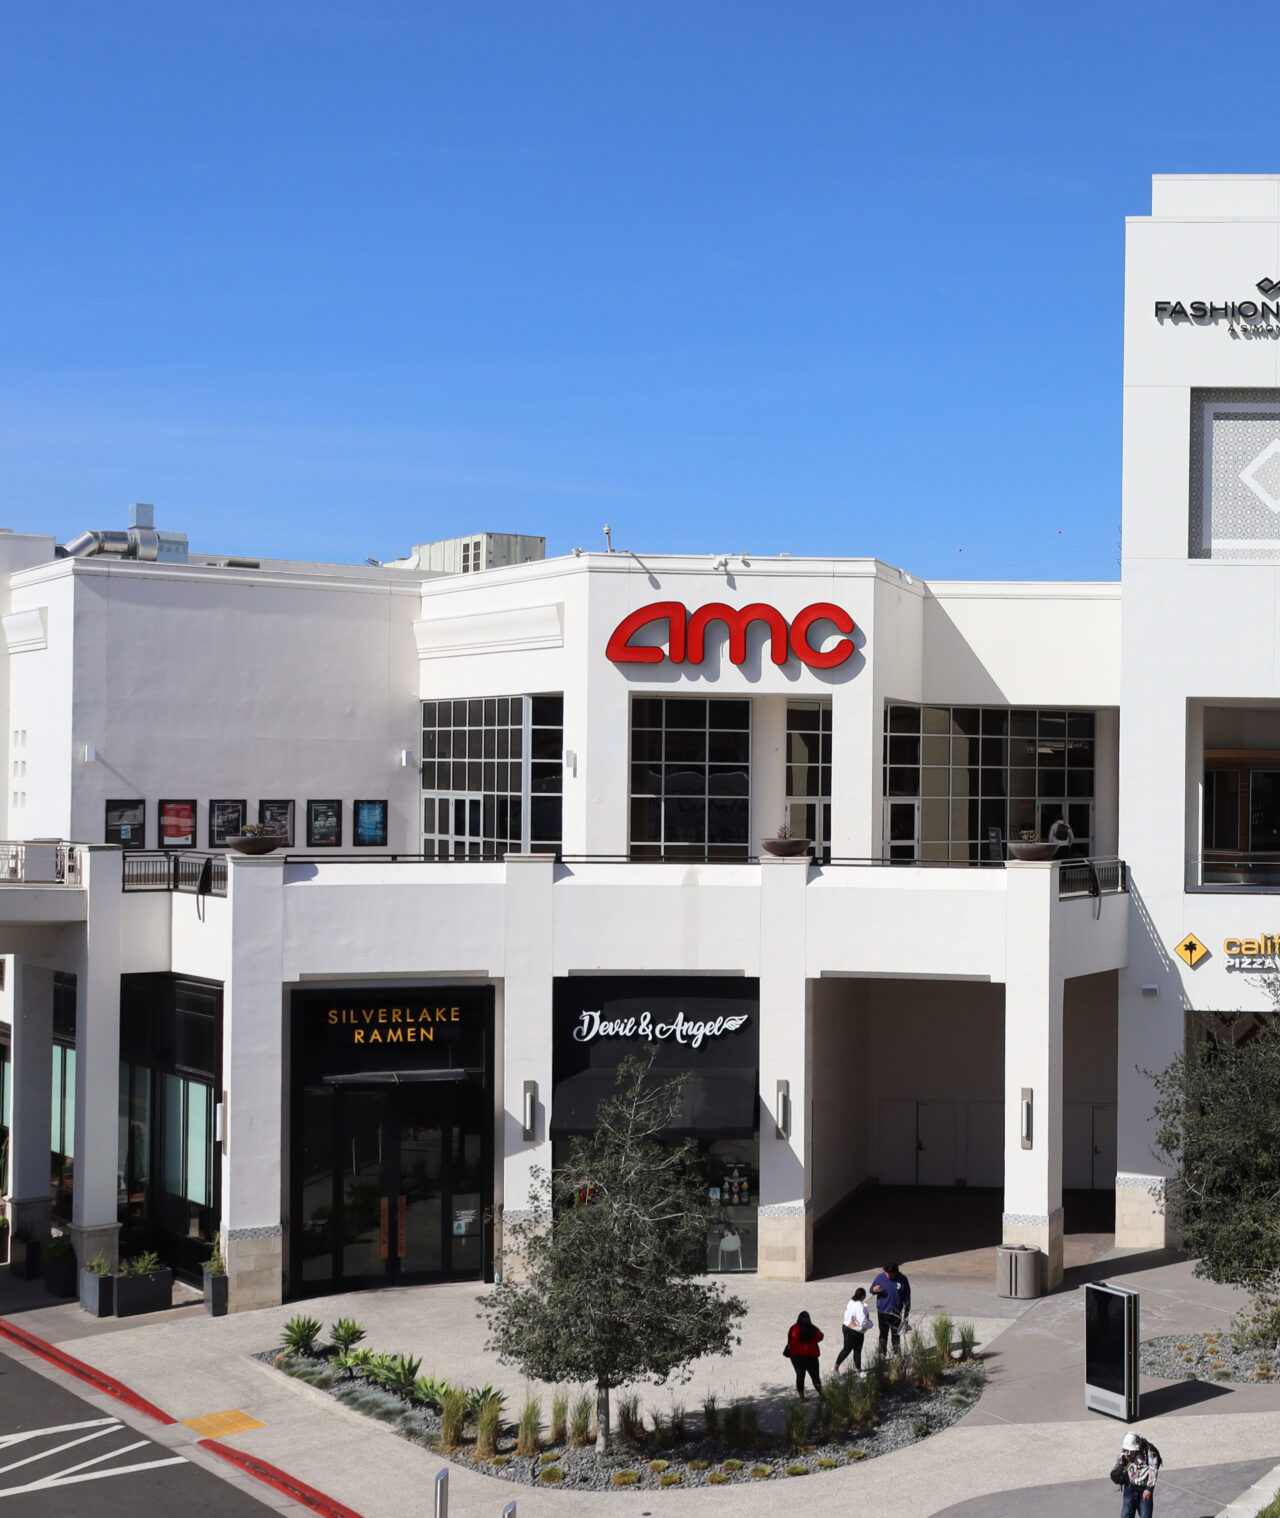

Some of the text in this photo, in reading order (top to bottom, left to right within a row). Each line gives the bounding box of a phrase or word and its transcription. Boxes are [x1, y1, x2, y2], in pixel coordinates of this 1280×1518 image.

[1154, 300, 1280, 318] FASHION
[604, 600, 856, 670] amc
[1223, 957, 1277, 970] PIZZA
[327, 1007, 461, 1025] SILVERLAKE
[353, 1026, 435, 1044] RAMEN
[572, 1009, 726, 1049] Devil & Angel
